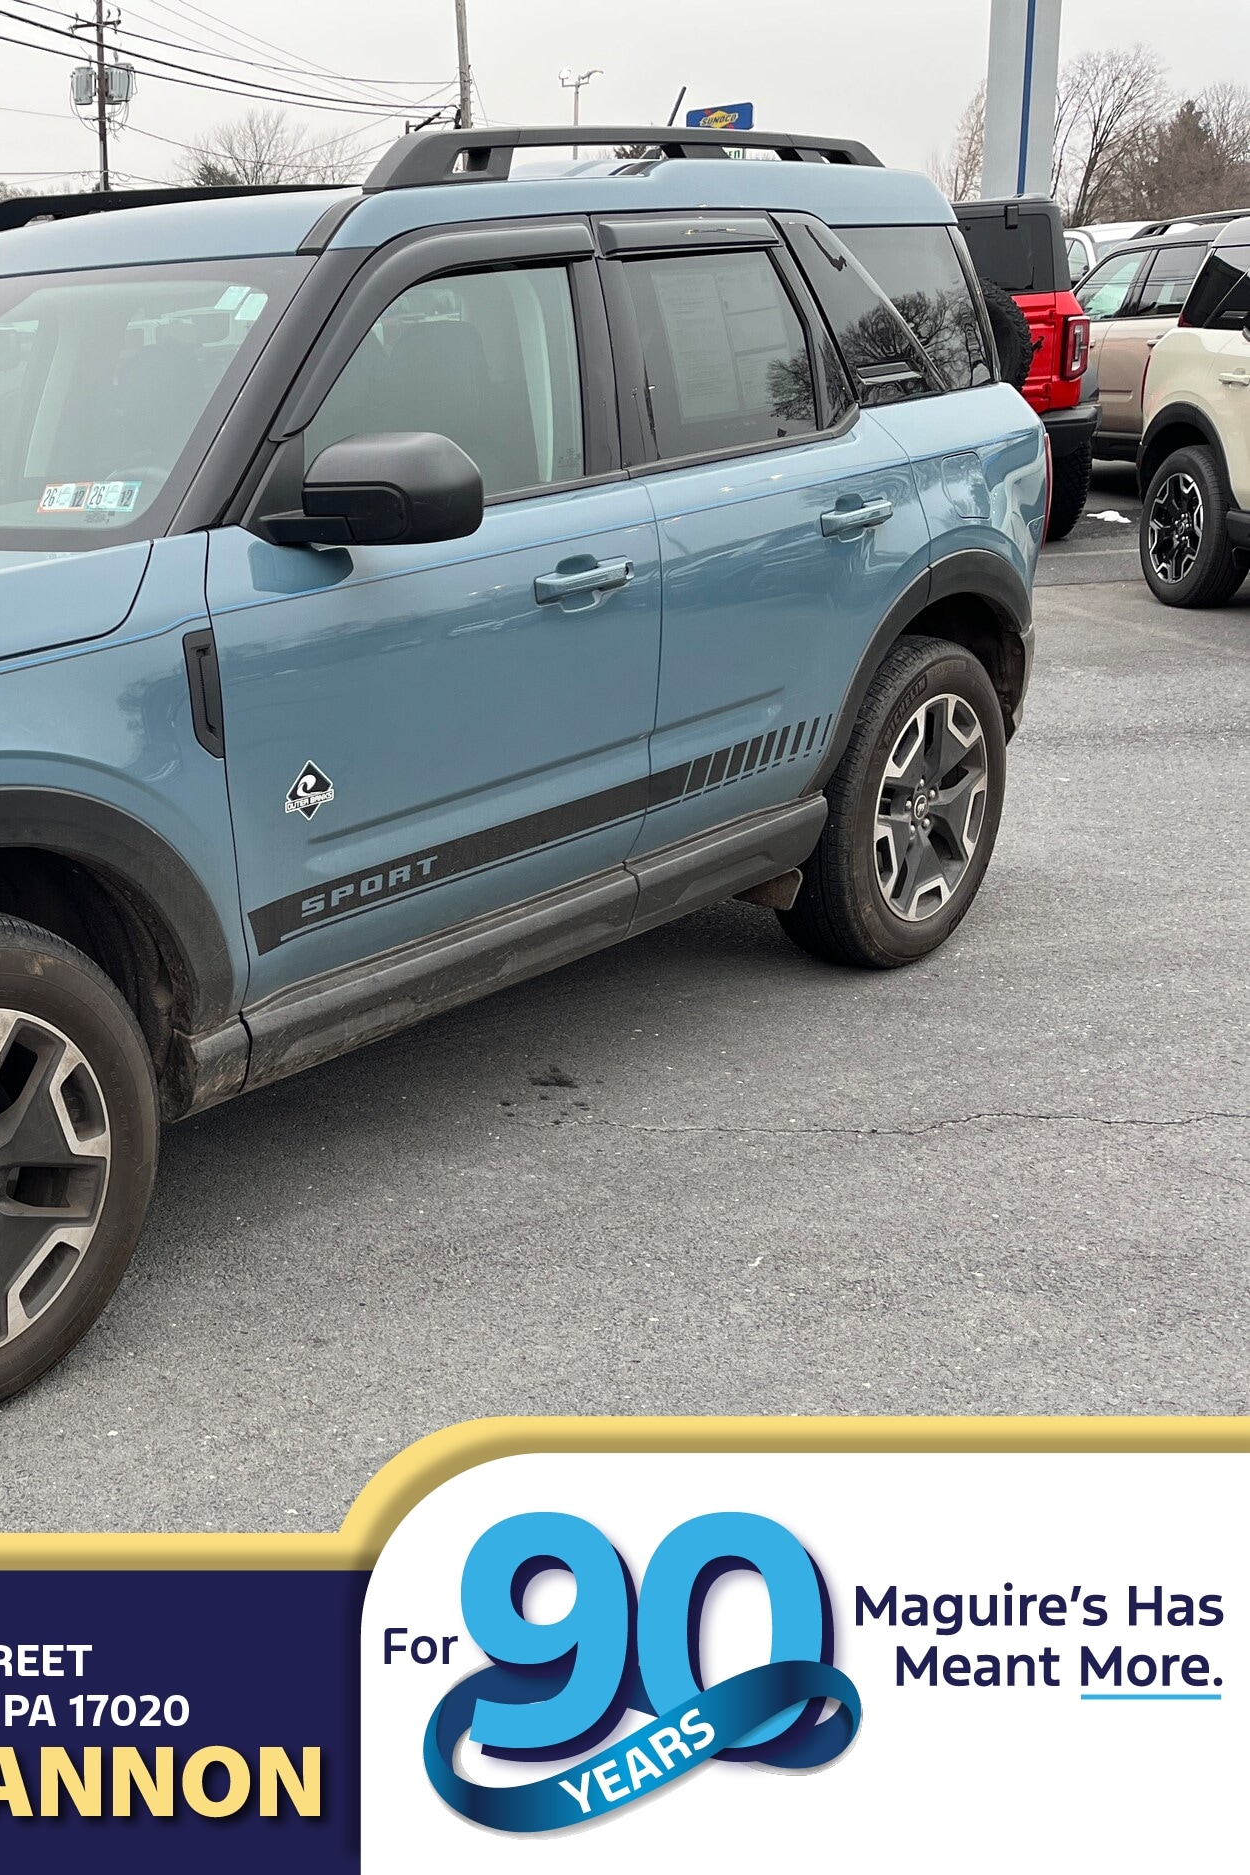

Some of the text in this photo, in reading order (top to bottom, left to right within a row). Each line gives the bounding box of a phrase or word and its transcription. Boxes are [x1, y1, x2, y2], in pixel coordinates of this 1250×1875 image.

[701, 113, 738, 126] SUNOCO
[42, 488, 86, 507] 26 12
[89, 485, 133, 507] 26 12
[883, 675, 928, 747] MICHELIN
[287, 790, 333, 811] OUTER BANKS
[301, 855, 438, 918] SPORT
